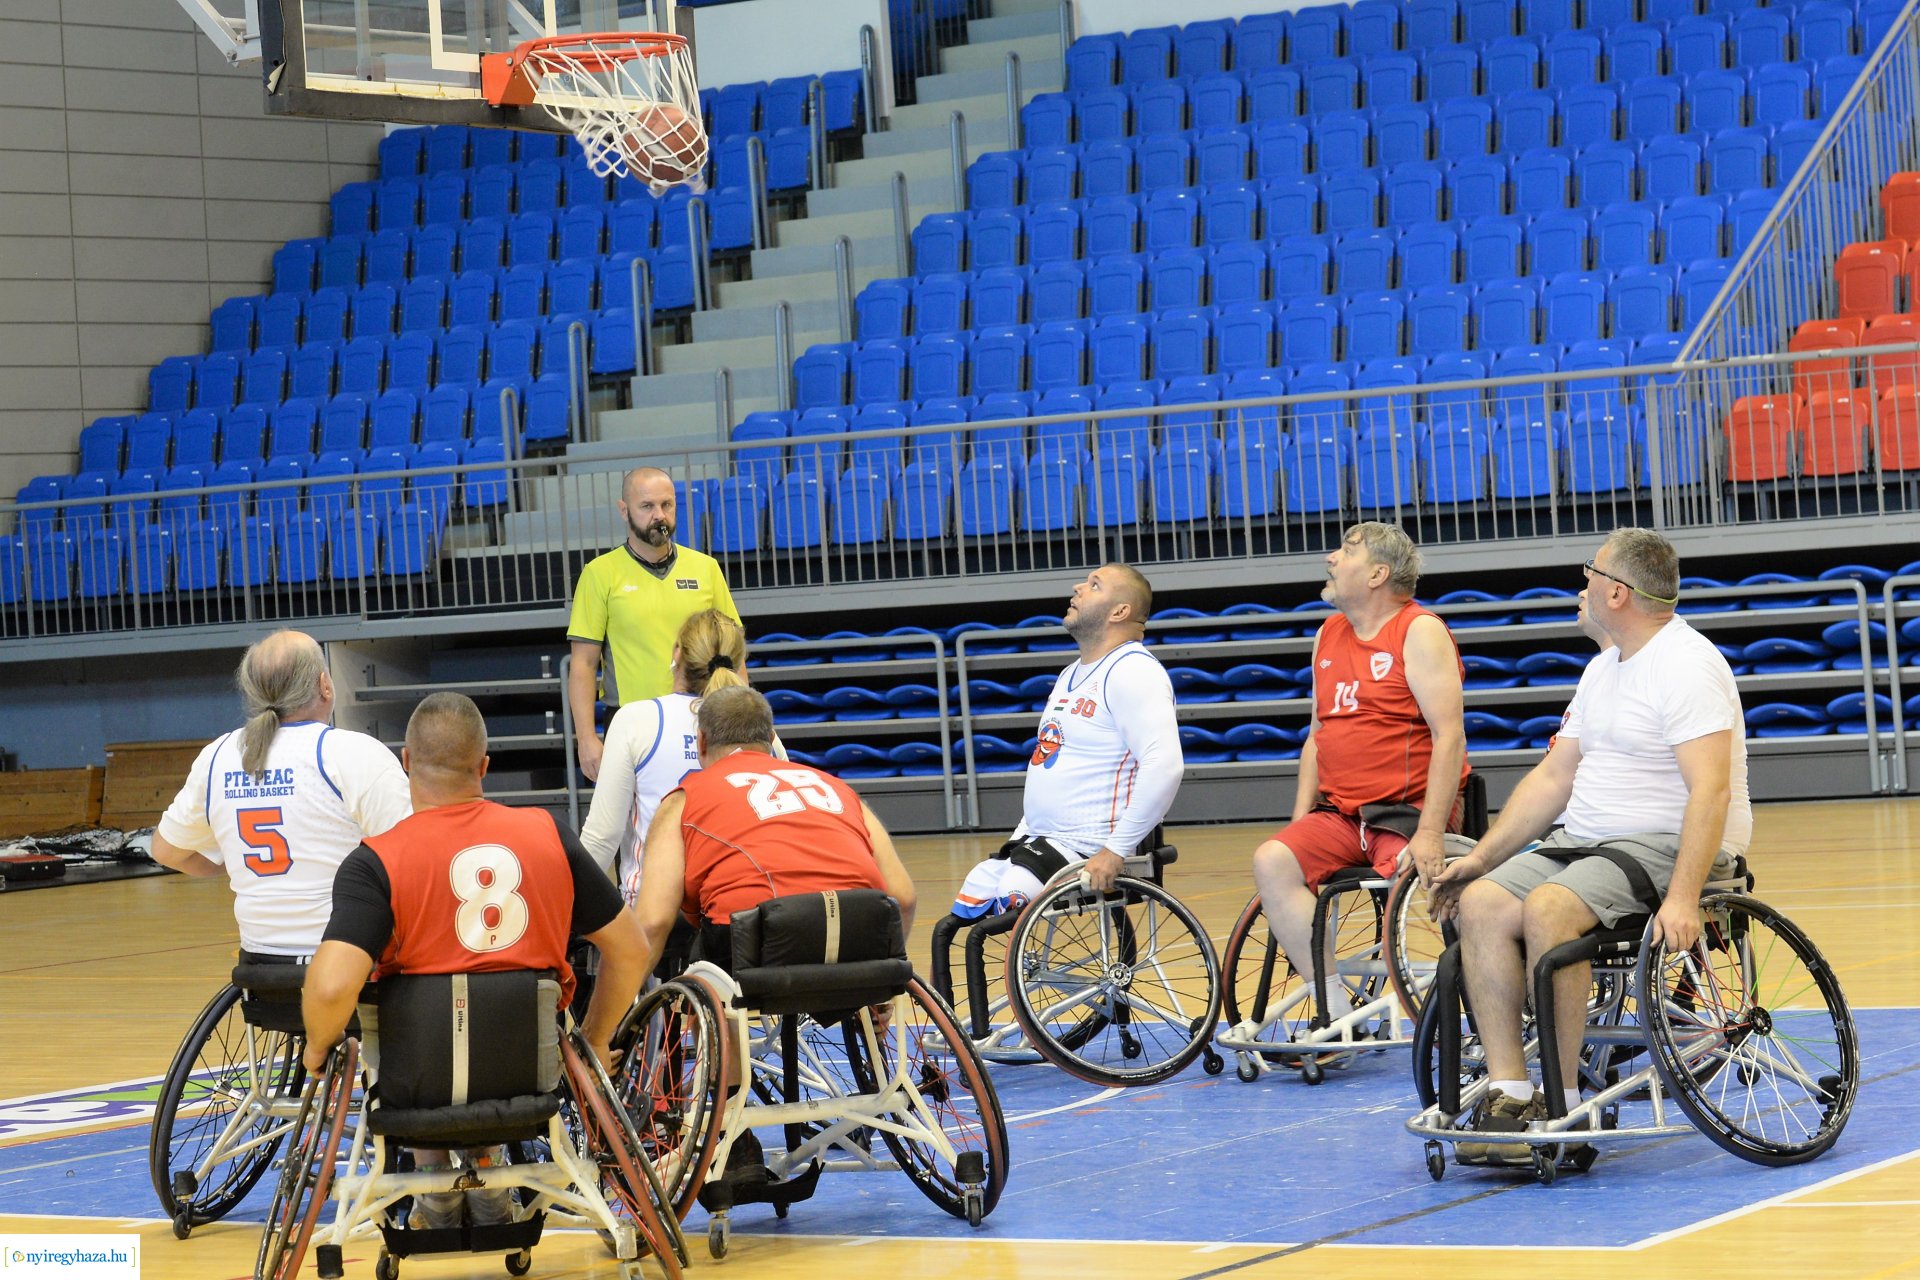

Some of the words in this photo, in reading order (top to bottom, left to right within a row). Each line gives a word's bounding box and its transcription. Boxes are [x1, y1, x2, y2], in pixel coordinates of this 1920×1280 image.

[1071, 697, 1097, 718] 30
[1329, 680, 1360, 714] 14
[684, 750, 699, 760] RO
[224, 771, 251, 788] PTE
[224, 788, 258, 799] ROLLING
[260, 786, 295, 797] BASKET
[724, 769, 844, 821] 25
[236, 806, 294, 877] 5
[449, 843, 529, 953] 8
